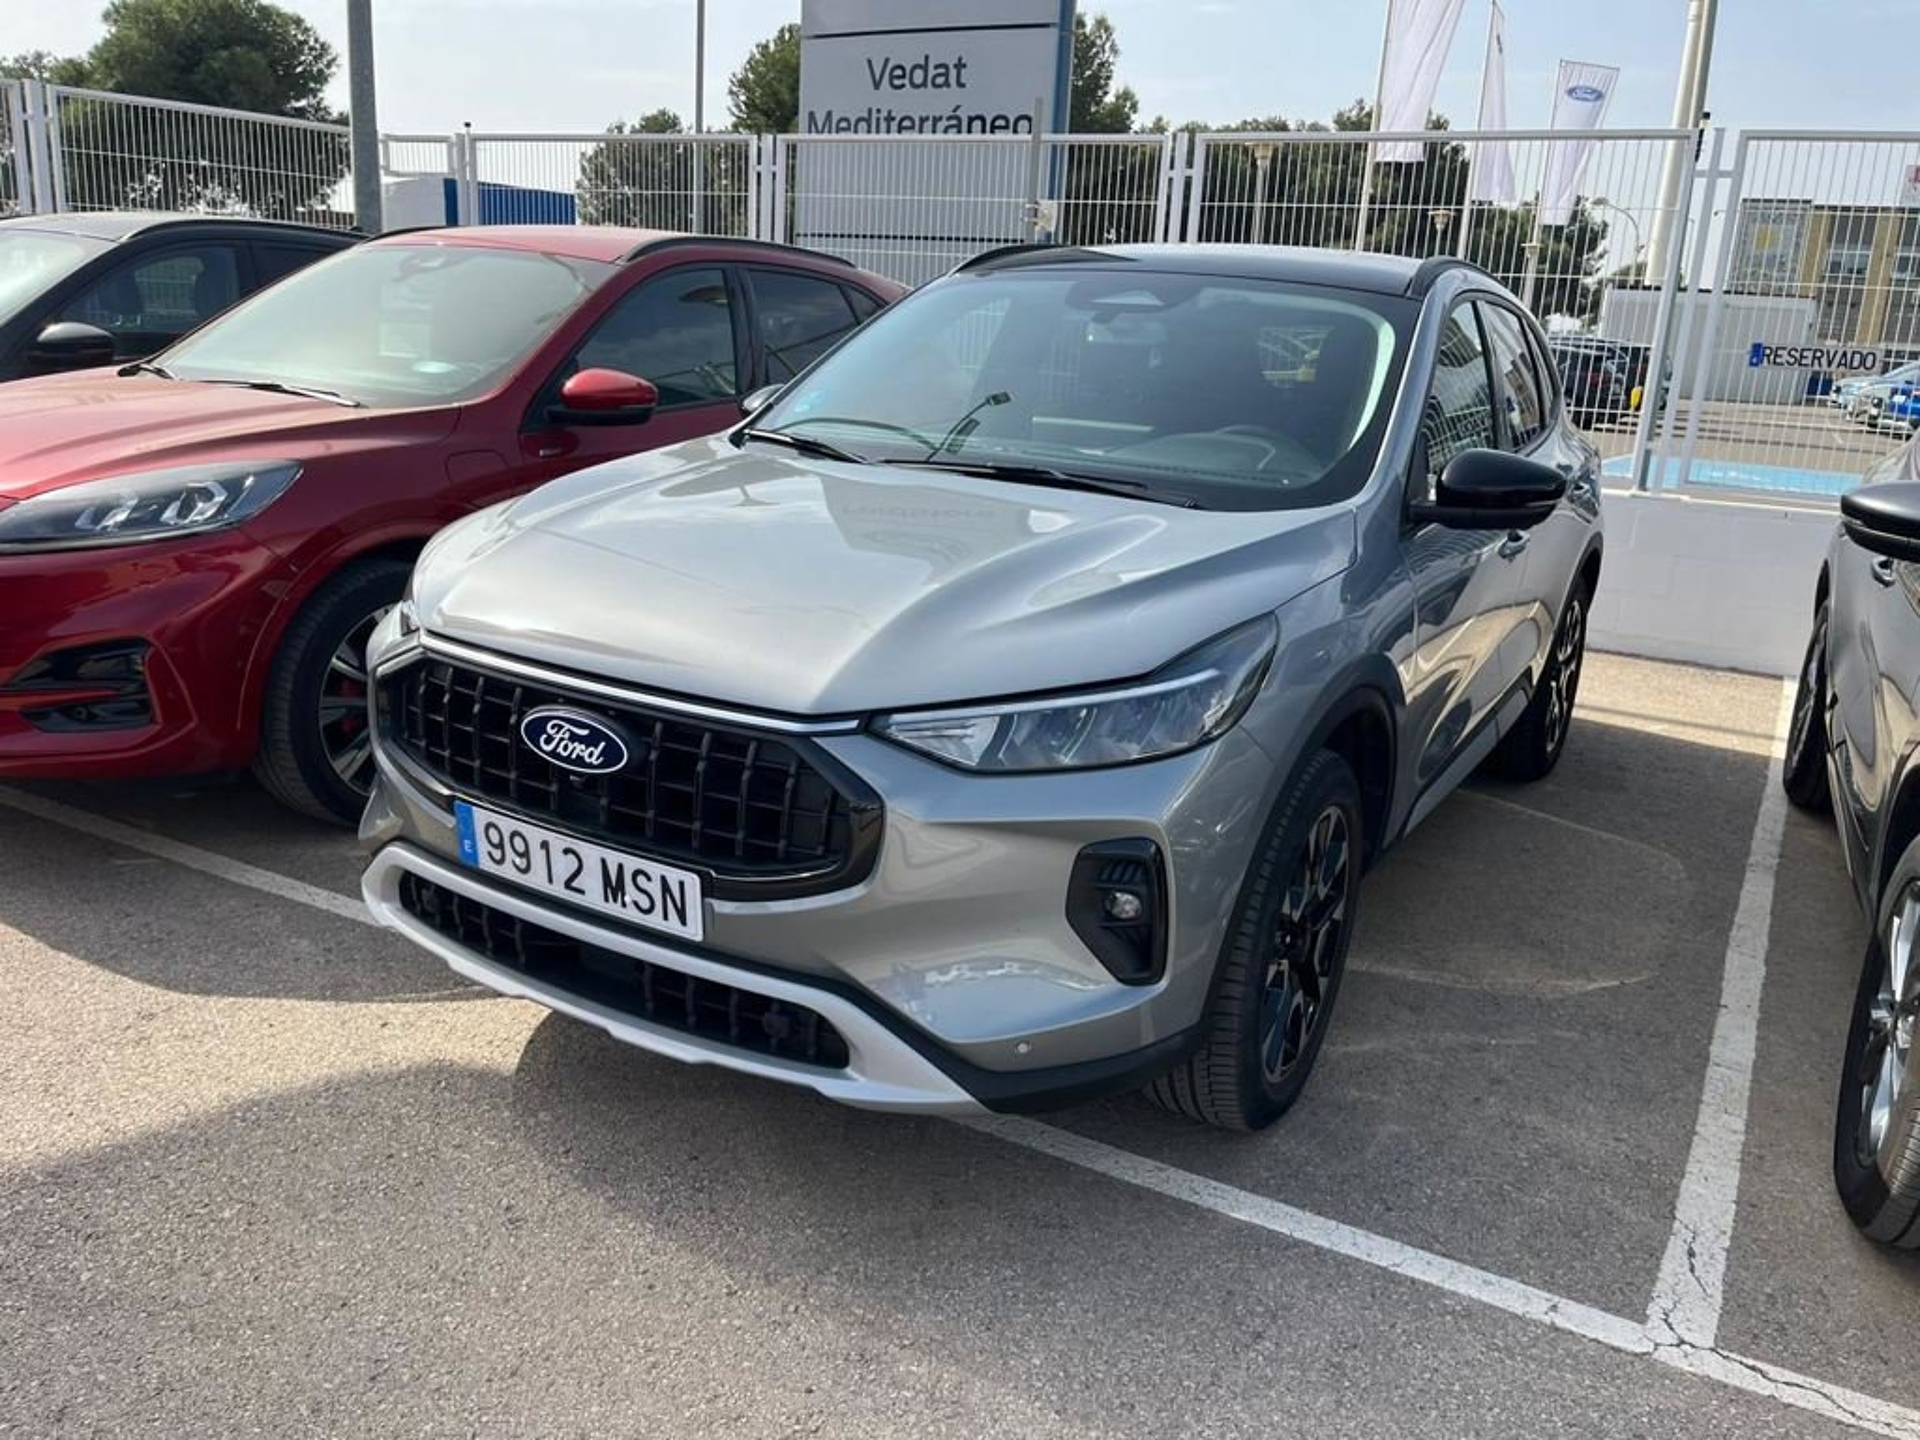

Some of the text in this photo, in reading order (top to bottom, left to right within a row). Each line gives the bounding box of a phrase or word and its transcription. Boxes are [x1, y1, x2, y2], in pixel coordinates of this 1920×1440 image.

[866, 54, 968, 91] Vedat
[1760, 346, 1877, 371] RESERVADO
[539, 719, 607, 766] Ford
[484, 821, 585, 896] 9912
[600, 857, 688, 927] MSN
